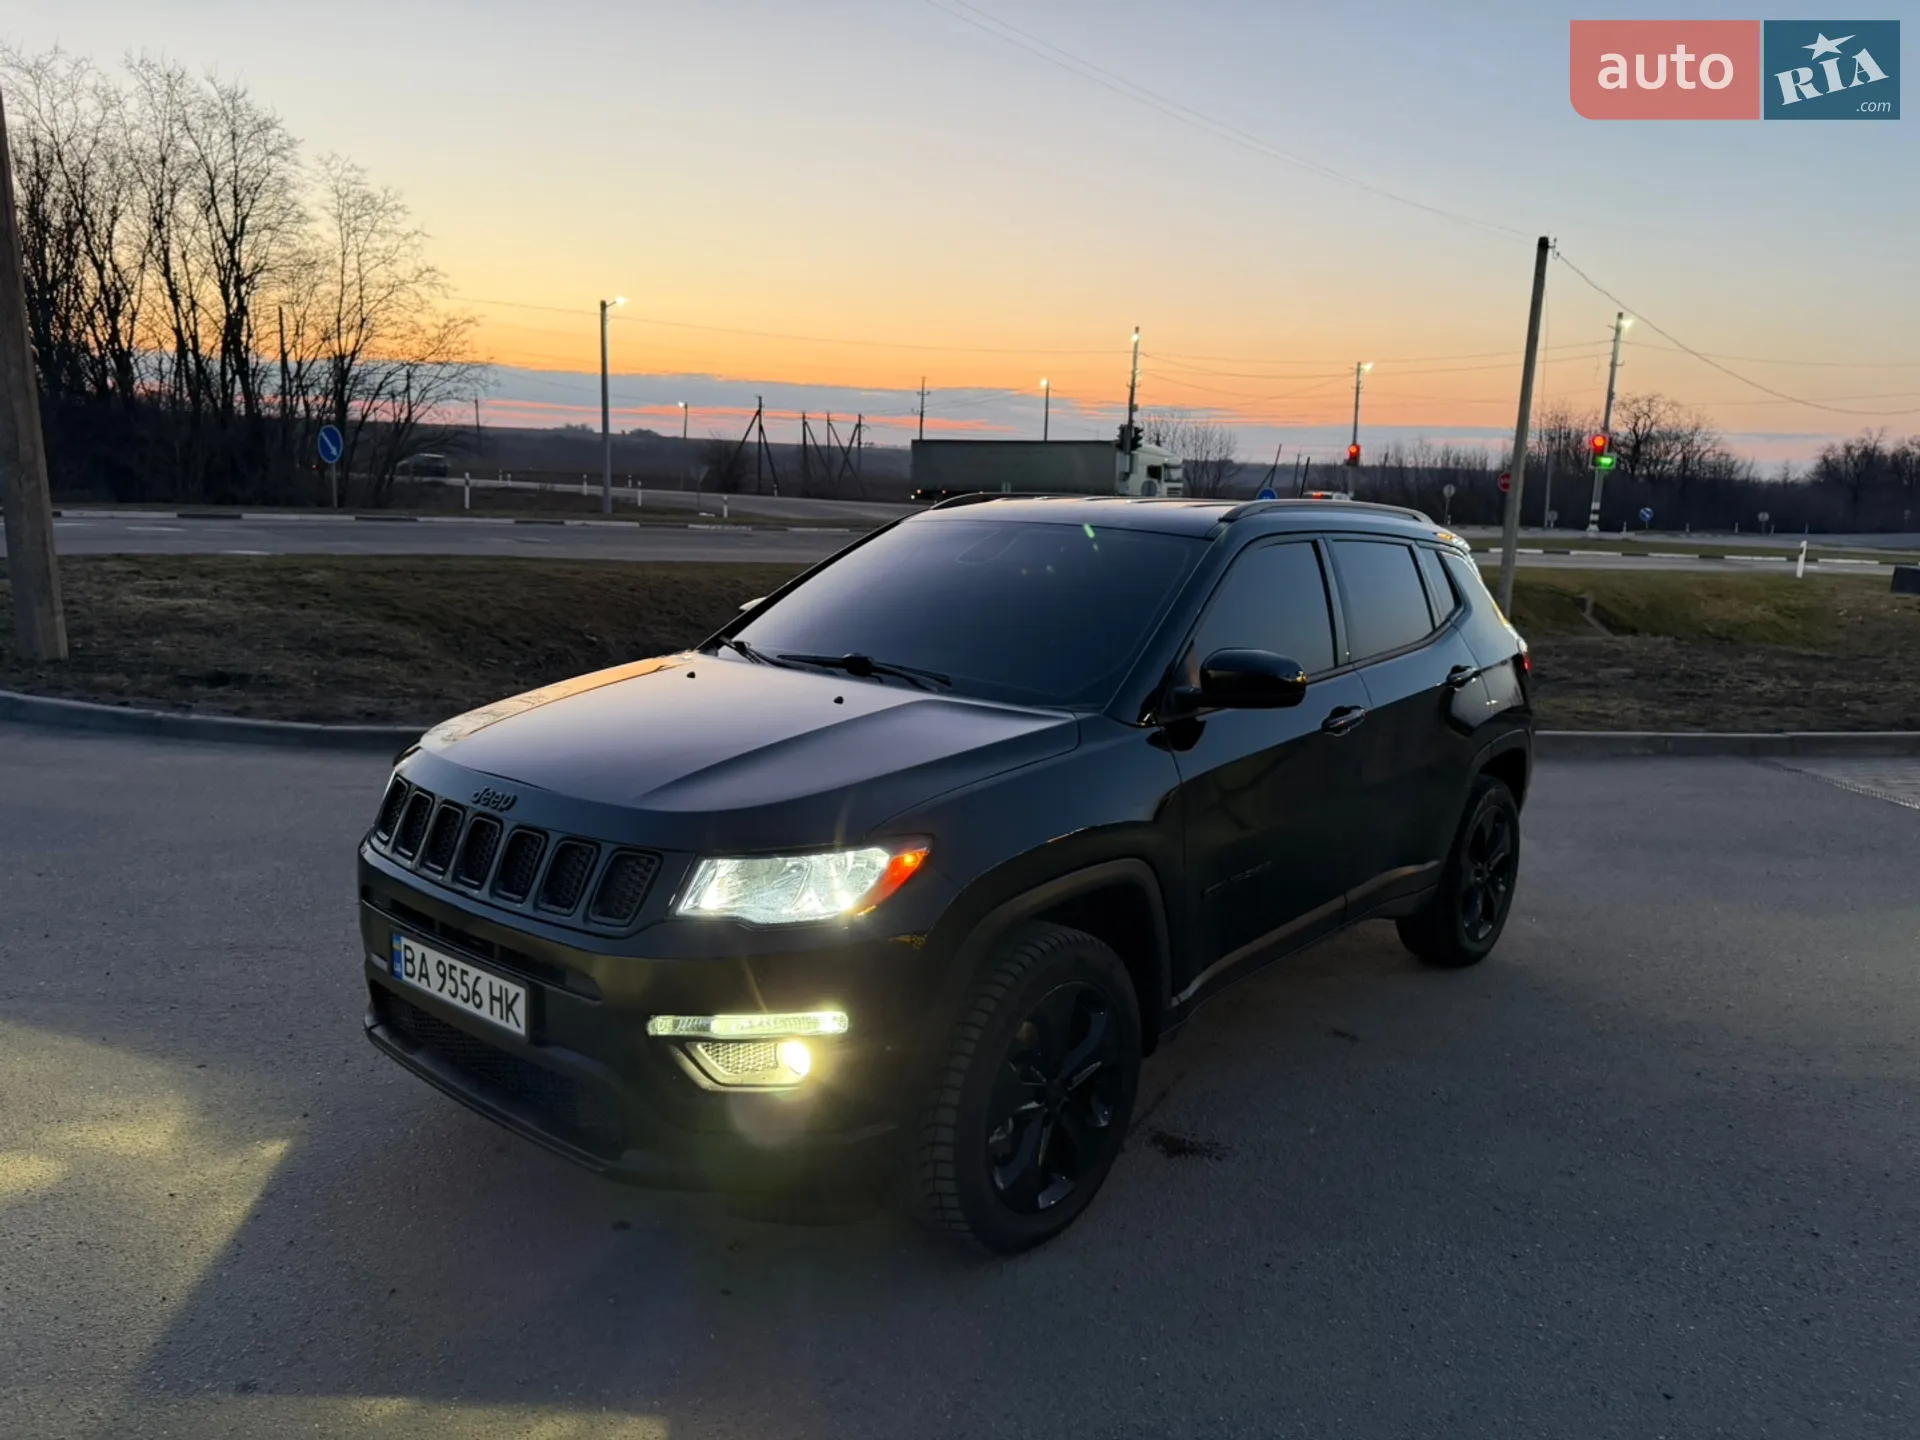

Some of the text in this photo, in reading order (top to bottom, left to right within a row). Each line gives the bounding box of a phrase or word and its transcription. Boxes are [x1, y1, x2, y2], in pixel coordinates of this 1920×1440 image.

[471, 786, 518, 812] Jeep
[403, 944, 521, 1029] BA 9556 HK
